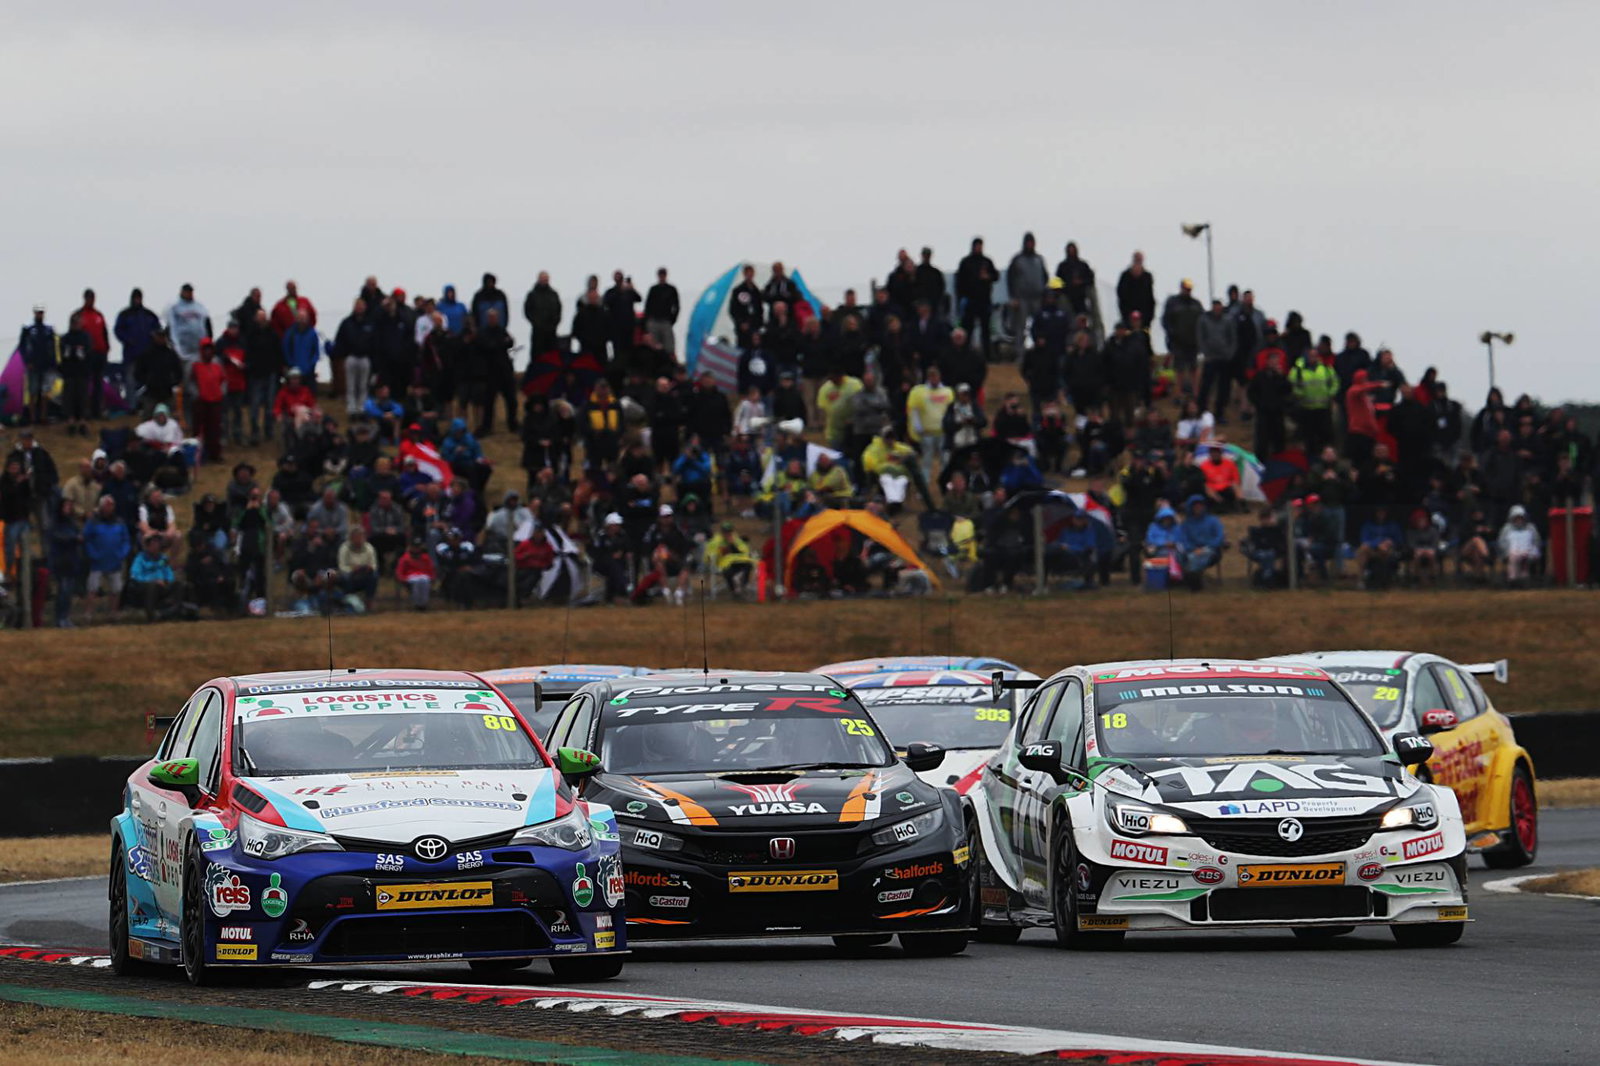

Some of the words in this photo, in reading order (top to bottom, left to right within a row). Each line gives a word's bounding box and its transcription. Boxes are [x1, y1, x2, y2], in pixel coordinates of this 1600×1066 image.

[1115, 666, 1304, 678] MOTUL
[249, 680, 370, 694] Hansford
[375, 679, 480, 688] Sensors
[614, 684, 834, 700] Pioneer
[302, 693, 438, 704] LOGISTICS
[1373, 687, 1399, 700] 20
[305, 702, 440, 712] PEOPLE
[616, 703, 759, 717] TYPE
[763, 697, 854, 714] R
[975, 708, 1011, 722] 303
[1101, 713, 1127, 729] 18
[483, 715, 517, 731] 80
[840, 718, 875, 736] 25
[1400, 737, 1431, 748] TAG
[1025, 745, 1054, 756] TAG
[1143, 762, 1391, 796] TAG
[320, 798, 429, 818] Hansford
[429, 797, 523, 811] Sensors
[727, 802, 828, 816] YUASA
[1242, 801, 1300, 814] LAPD
[1415, 806, 1434, 819] HiQ
[1125, 815, 1149, 828] HiQ
[895, 824, 916, 839] HiQ
[636, 831, 660, 847] HiQ
[245, 839, 264, 853] HiQ
[1112, 843, 1164, 862] MOTUL
[1406, 835, 1443, 858] MOTUL
[376, 854, 404, 865] SAS
[456, 851, 483, 864] SAS
[457, 860, 484, 870] ENERGY
[895, 861, 943, 879] halfords
[747, 875, 837, 886] DUNLOP
[1198, 871, 1220, 880] ABS
[1256, 869, 1344, 881] DUNLOP
[1395, 871, 1445, 883] VIEZU
[216, 876, 249, 904] reis
[1118, 879, 1179, 889] VIEZU
[396, 888, 493, 902] DUNLOP
[886, 889, 912, 901] Castrol
[658, 897, 687, 907] Castrol
[221, 928, 252, 939] MOTUL
